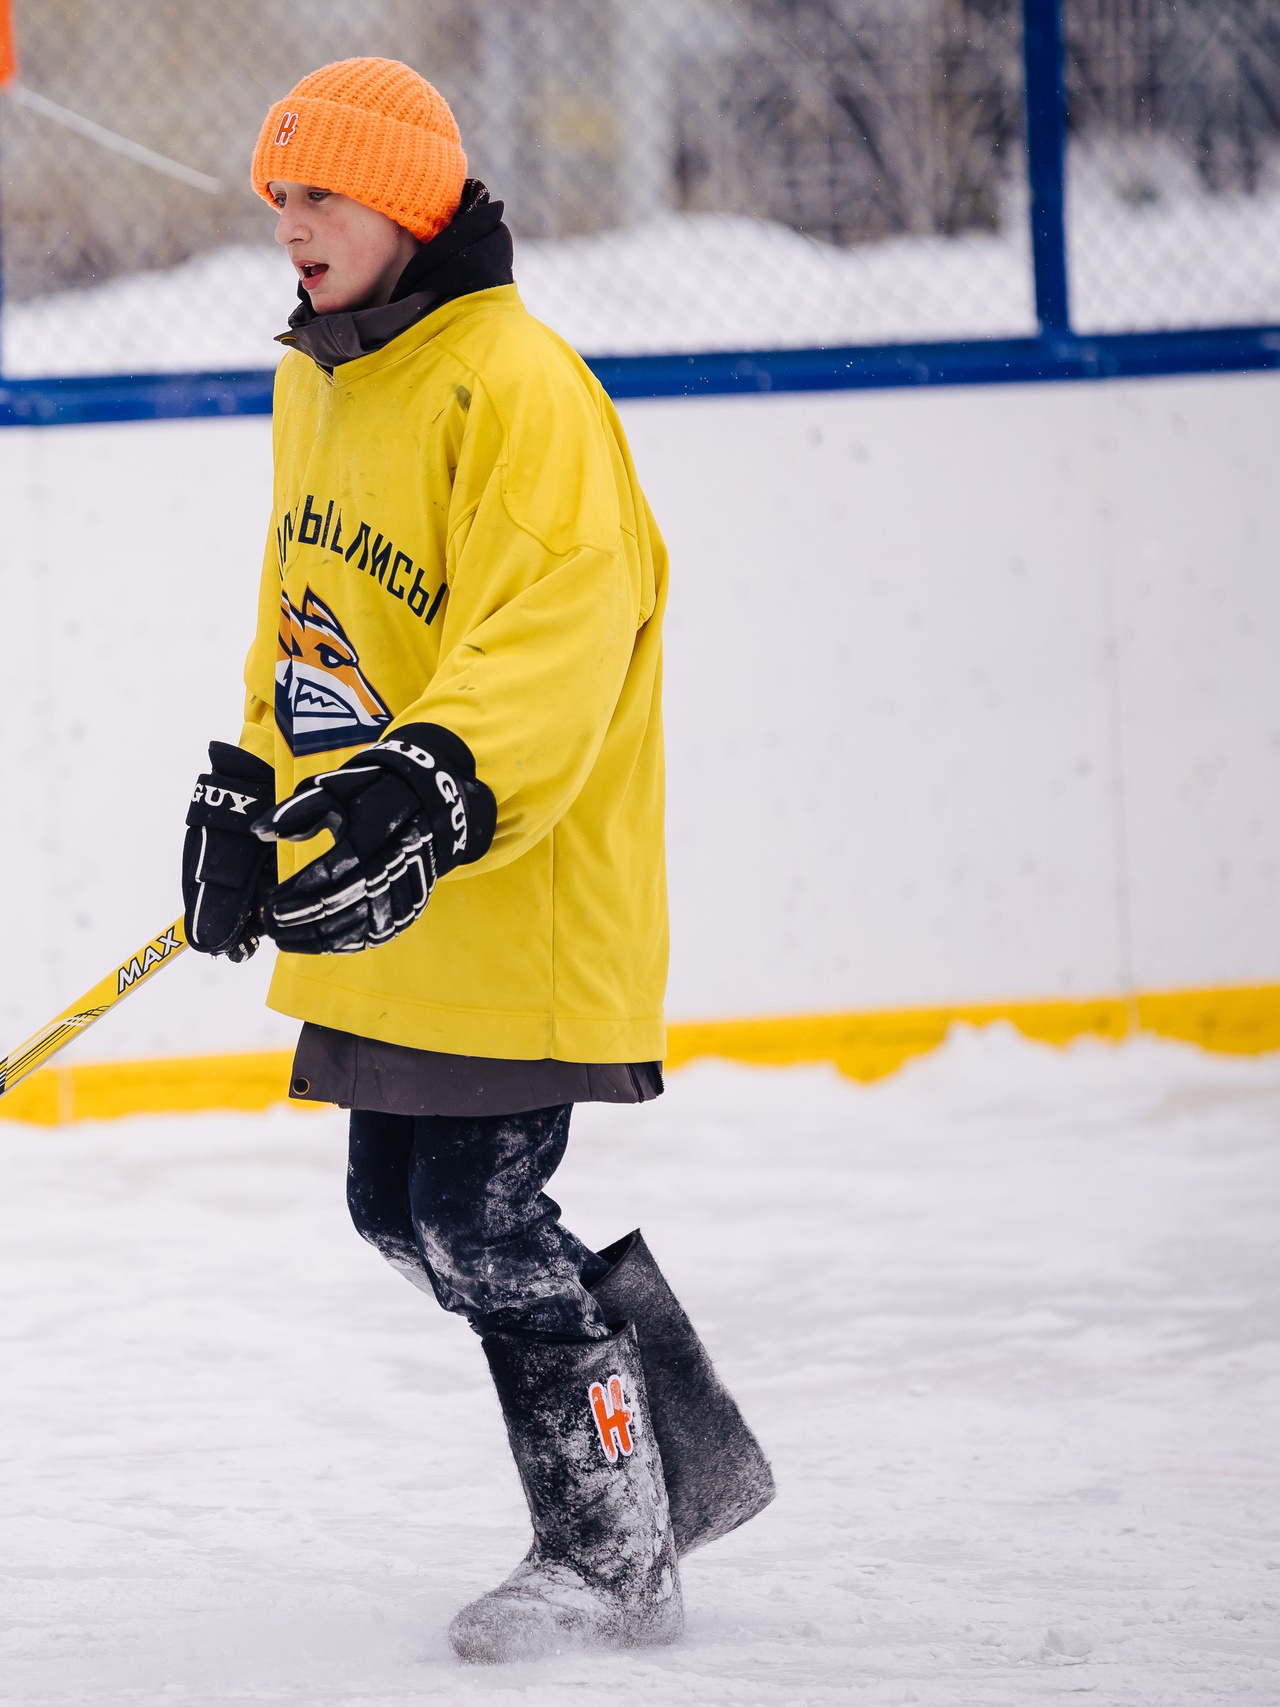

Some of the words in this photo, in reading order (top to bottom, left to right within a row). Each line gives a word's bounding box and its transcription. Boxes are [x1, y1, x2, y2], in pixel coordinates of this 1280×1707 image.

[344, 520, 448, 626] ЛИСЫ
[191, 783, 258, 815] GUY
[435, 770, 468, 855] GUY
[117, 925, 184, 996] MAX
